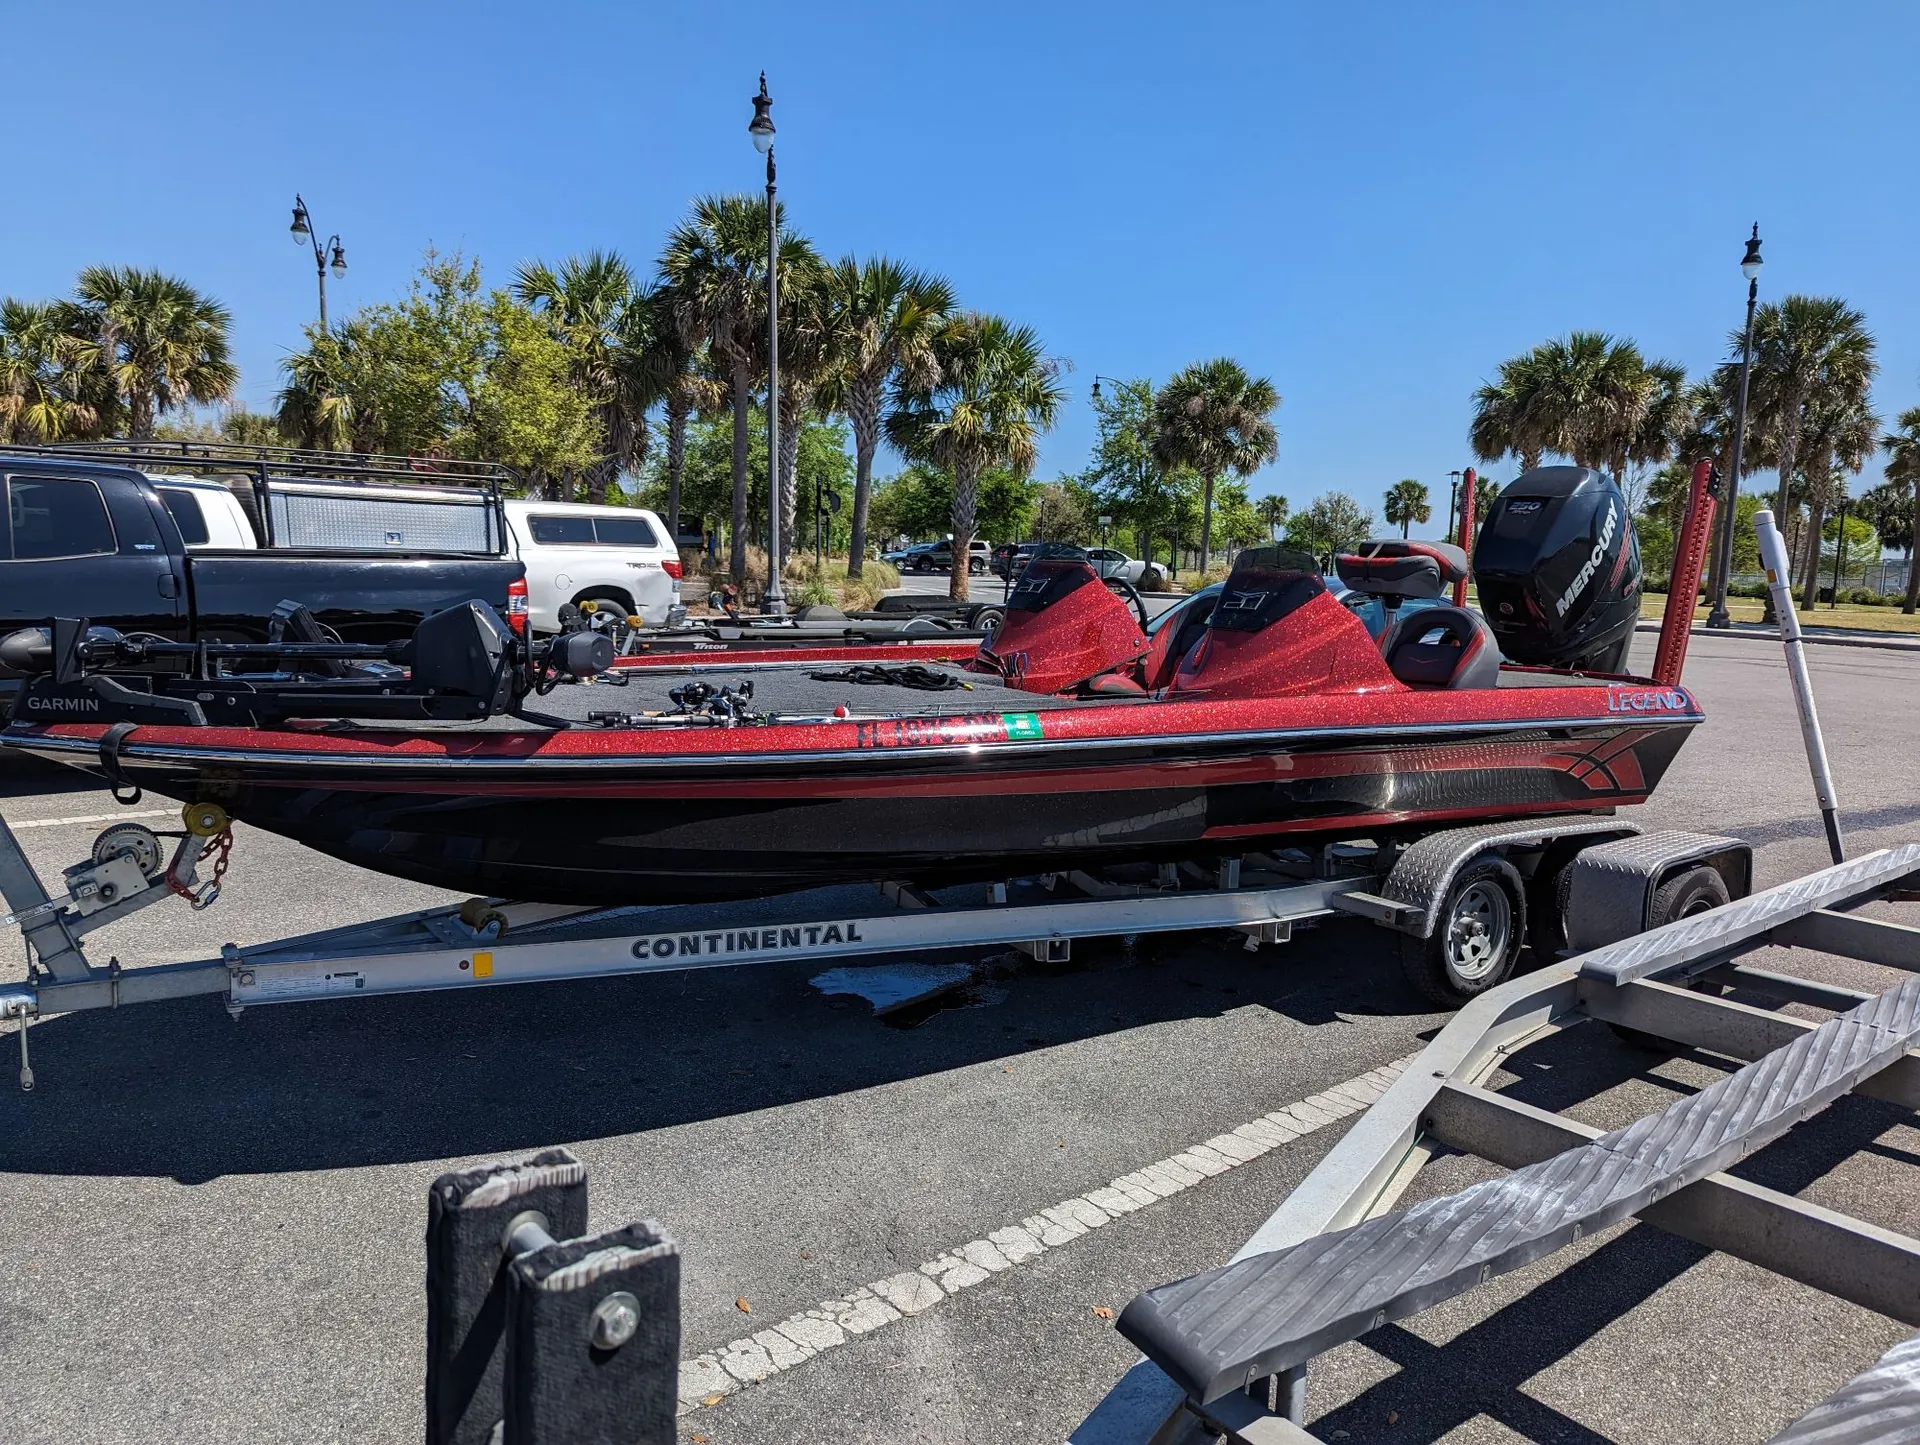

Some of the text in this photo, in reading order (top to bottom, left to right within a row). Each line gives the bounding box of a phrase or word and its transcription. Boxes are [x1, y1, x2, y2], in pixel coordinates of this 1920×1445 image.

[1508, 501, 1542, 512] 250
[1556, 497, 1618, 618] MERCURY
[693, 642, 729, 650] Triton
[27, 696, 99, 712] GARMIN
[1608, 690, 1688, 712] LEGEND
[631, 922, 863, 960] CONTINENTAL
